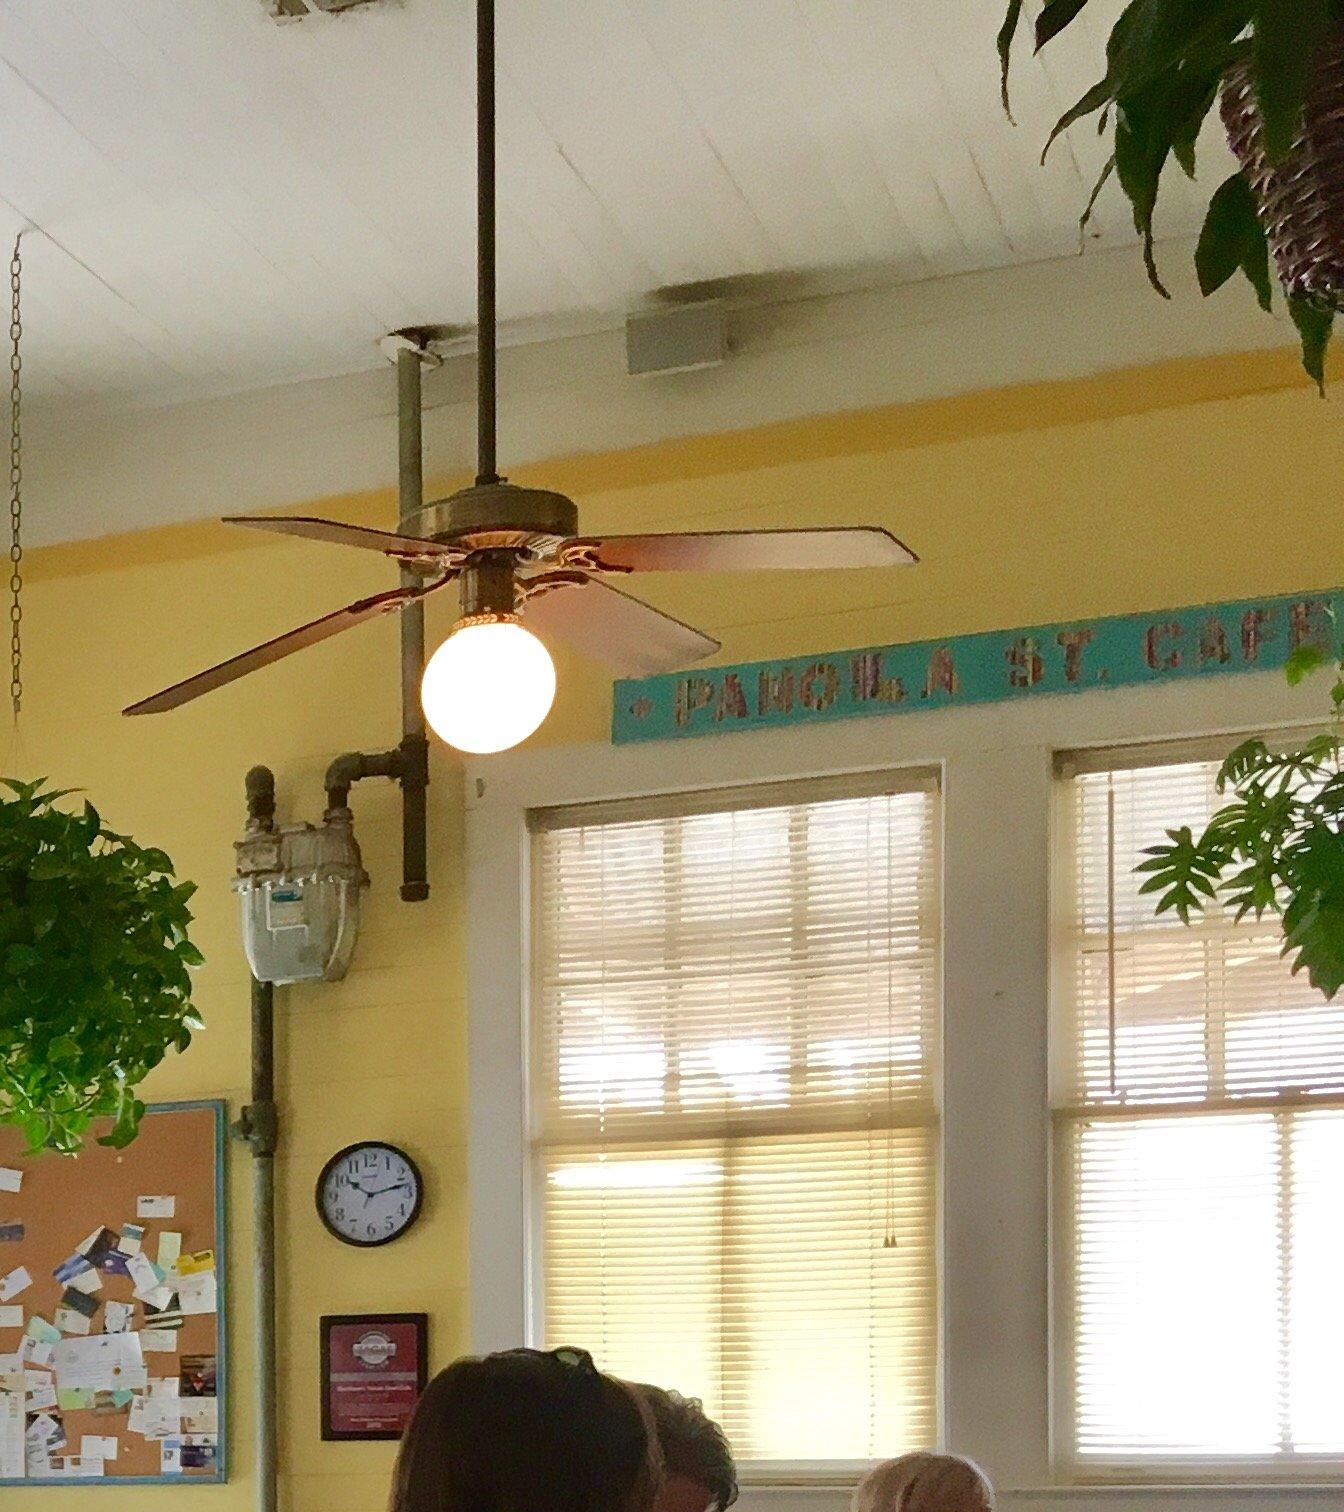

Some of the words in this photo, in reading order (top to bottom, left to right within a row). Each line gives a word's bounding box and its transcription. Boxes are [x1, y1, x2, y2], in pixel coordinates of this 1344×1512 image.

[673, 647, 963, 727] PANOLA
[348, 1159, 359, 1173] 11
[364, 1154, 377, 1168] 12
[397, 1167, 405, 1181] 2
[367, 1223, 376, 1235] 6
